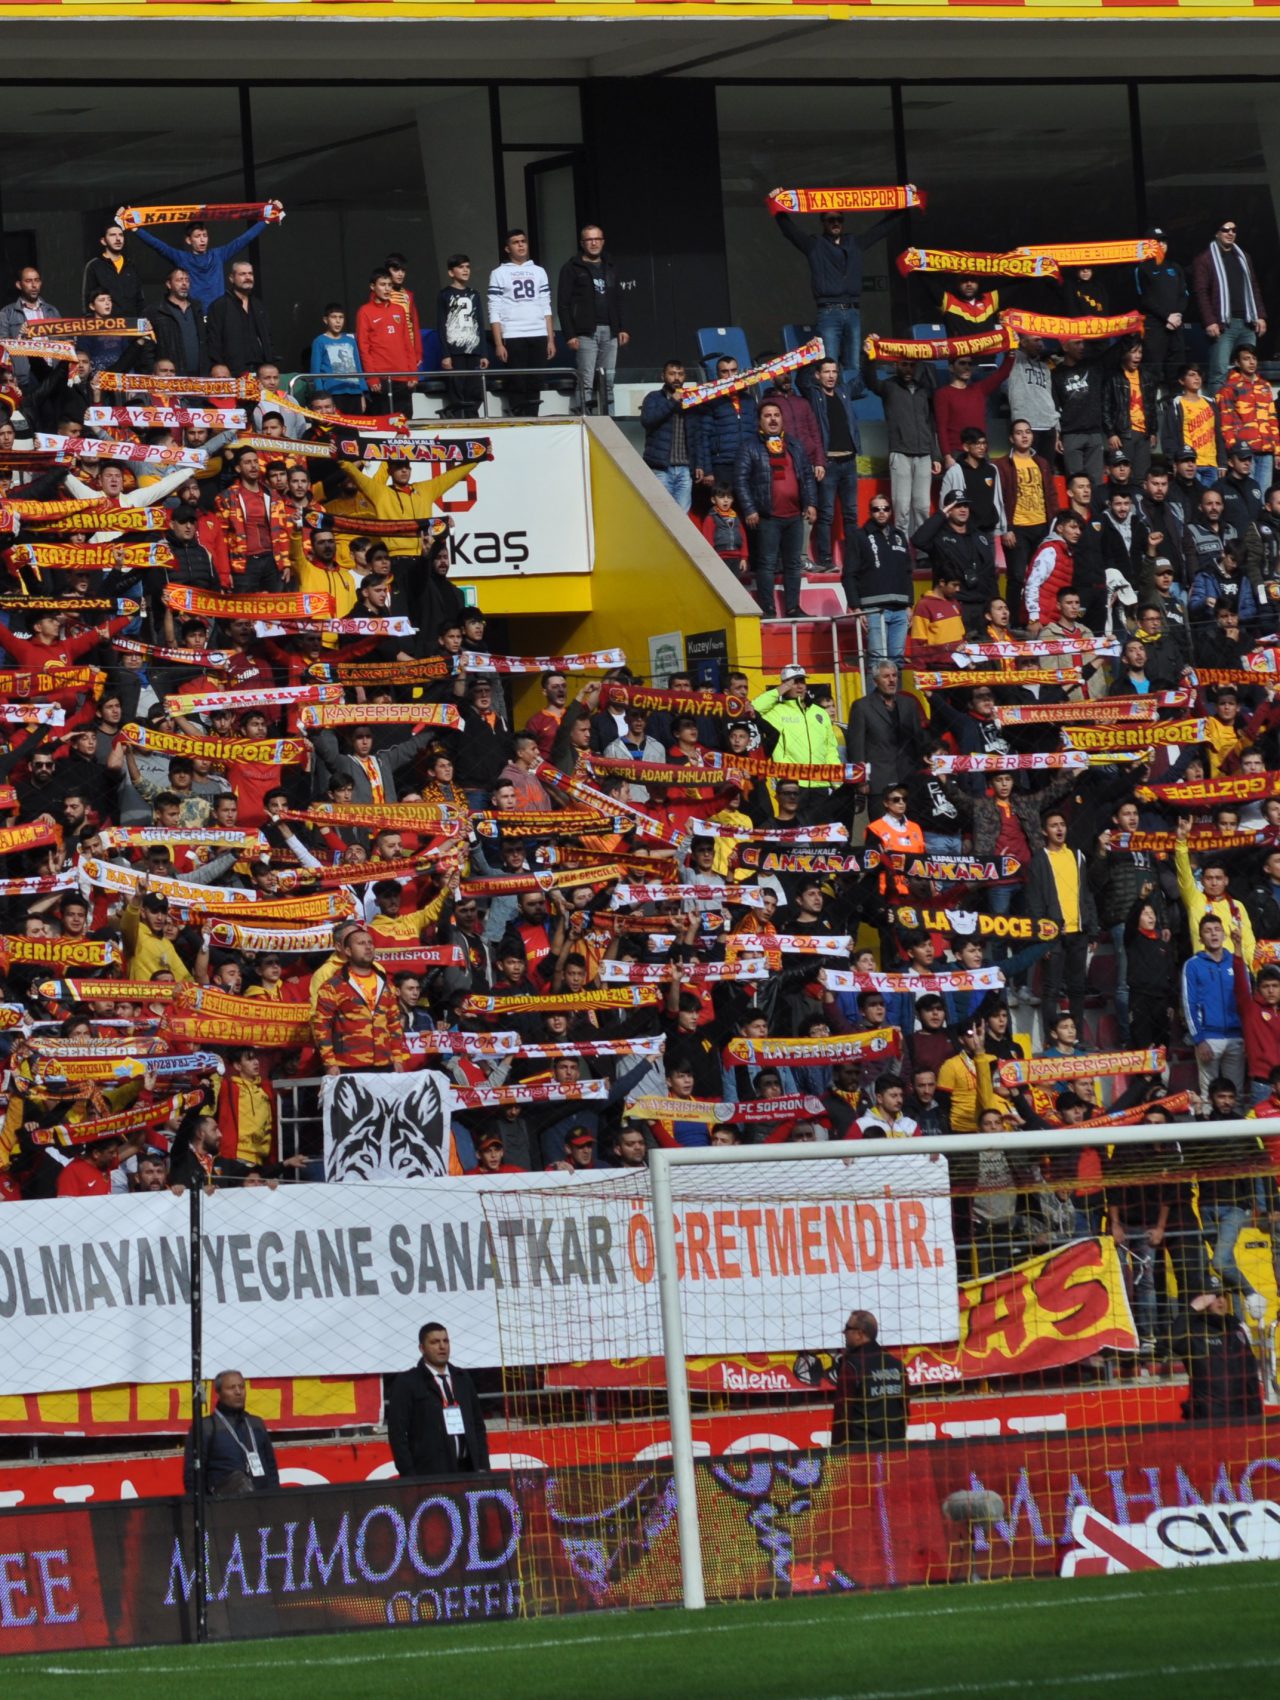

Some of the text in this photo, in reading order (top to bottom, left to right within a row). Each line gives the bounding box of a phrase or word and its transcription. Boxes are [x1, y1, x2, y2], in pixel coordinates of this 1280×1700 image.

[512, 279, 536, 300] 28
[363, 443, 463, 461] ANKARA
[908, 862, 999, 880] ANKARA
[922, 910, 1032, 937] LA DOCE
[200, 1226, 379, 1304] YEGANE
[390, 1215, 618, 1294] SANATKAR
[163, 1489, 521, 1606] MAHMOOD
